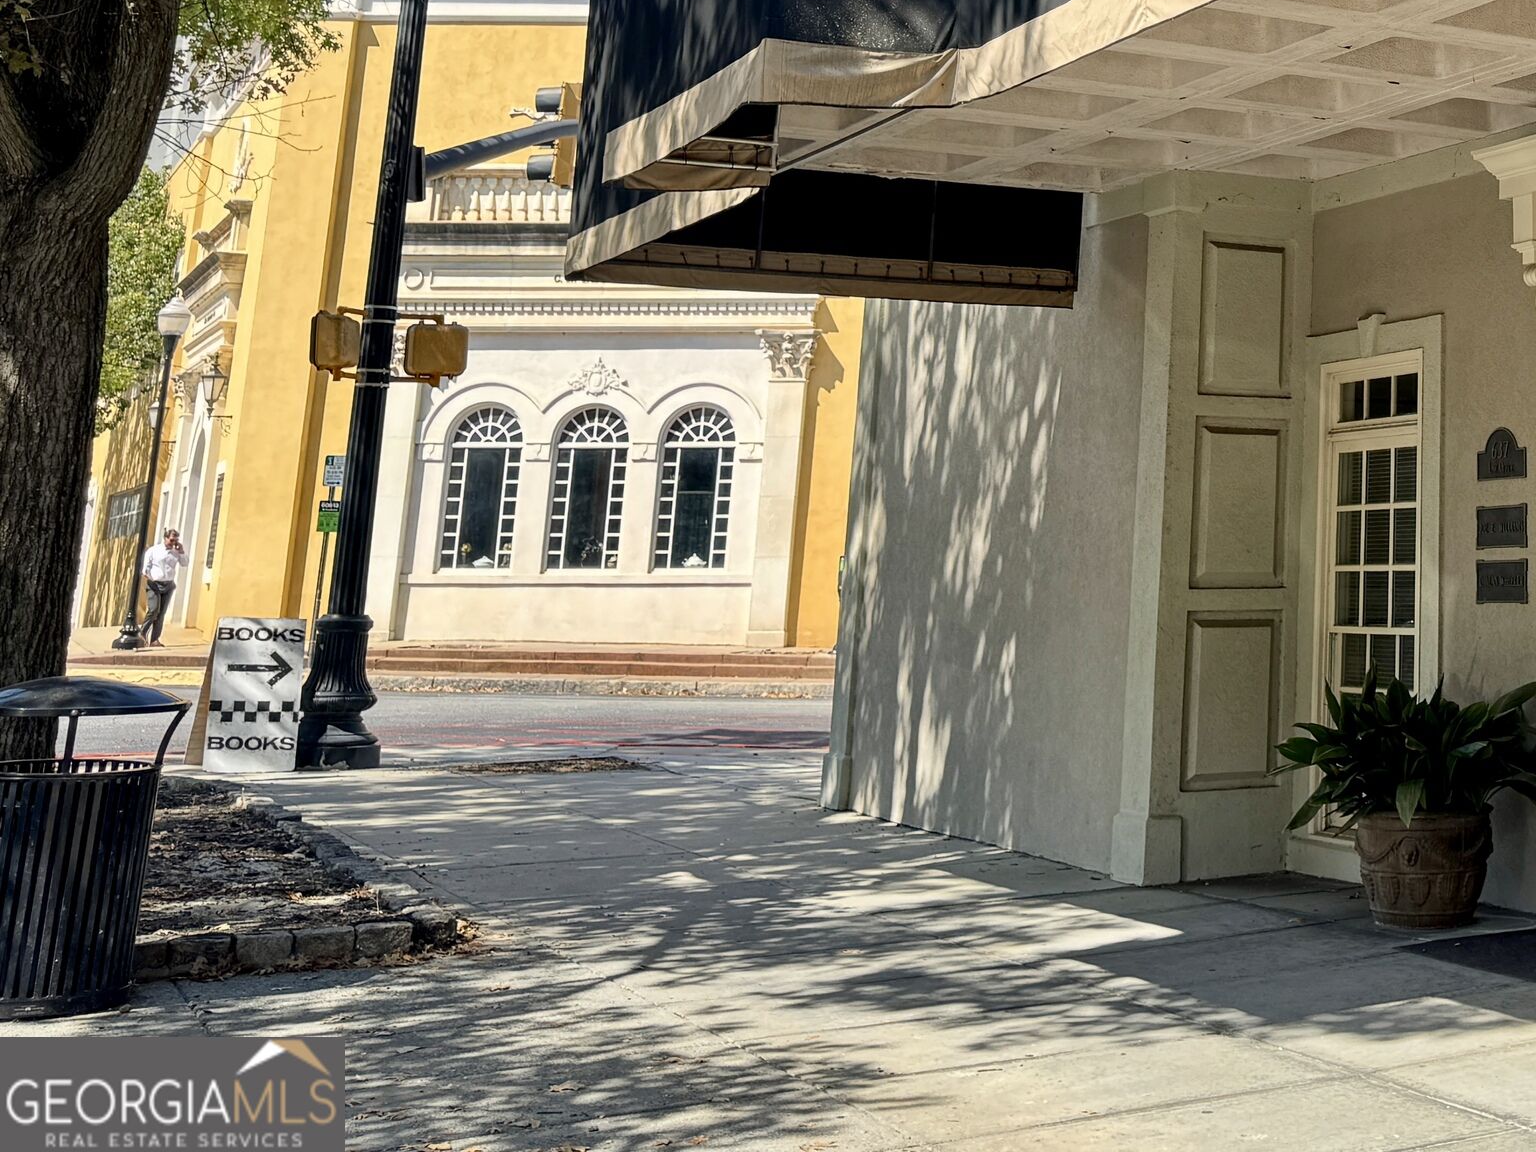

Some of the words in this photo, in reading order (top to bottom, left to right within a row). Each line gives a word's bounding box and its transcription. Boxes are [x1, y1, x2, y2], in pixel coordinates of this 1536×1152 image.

[1491, 441, 1509, 459] 637
[217, 627, 306, 642] BOOKS
[207, 736, 295, 750] BOOKS
